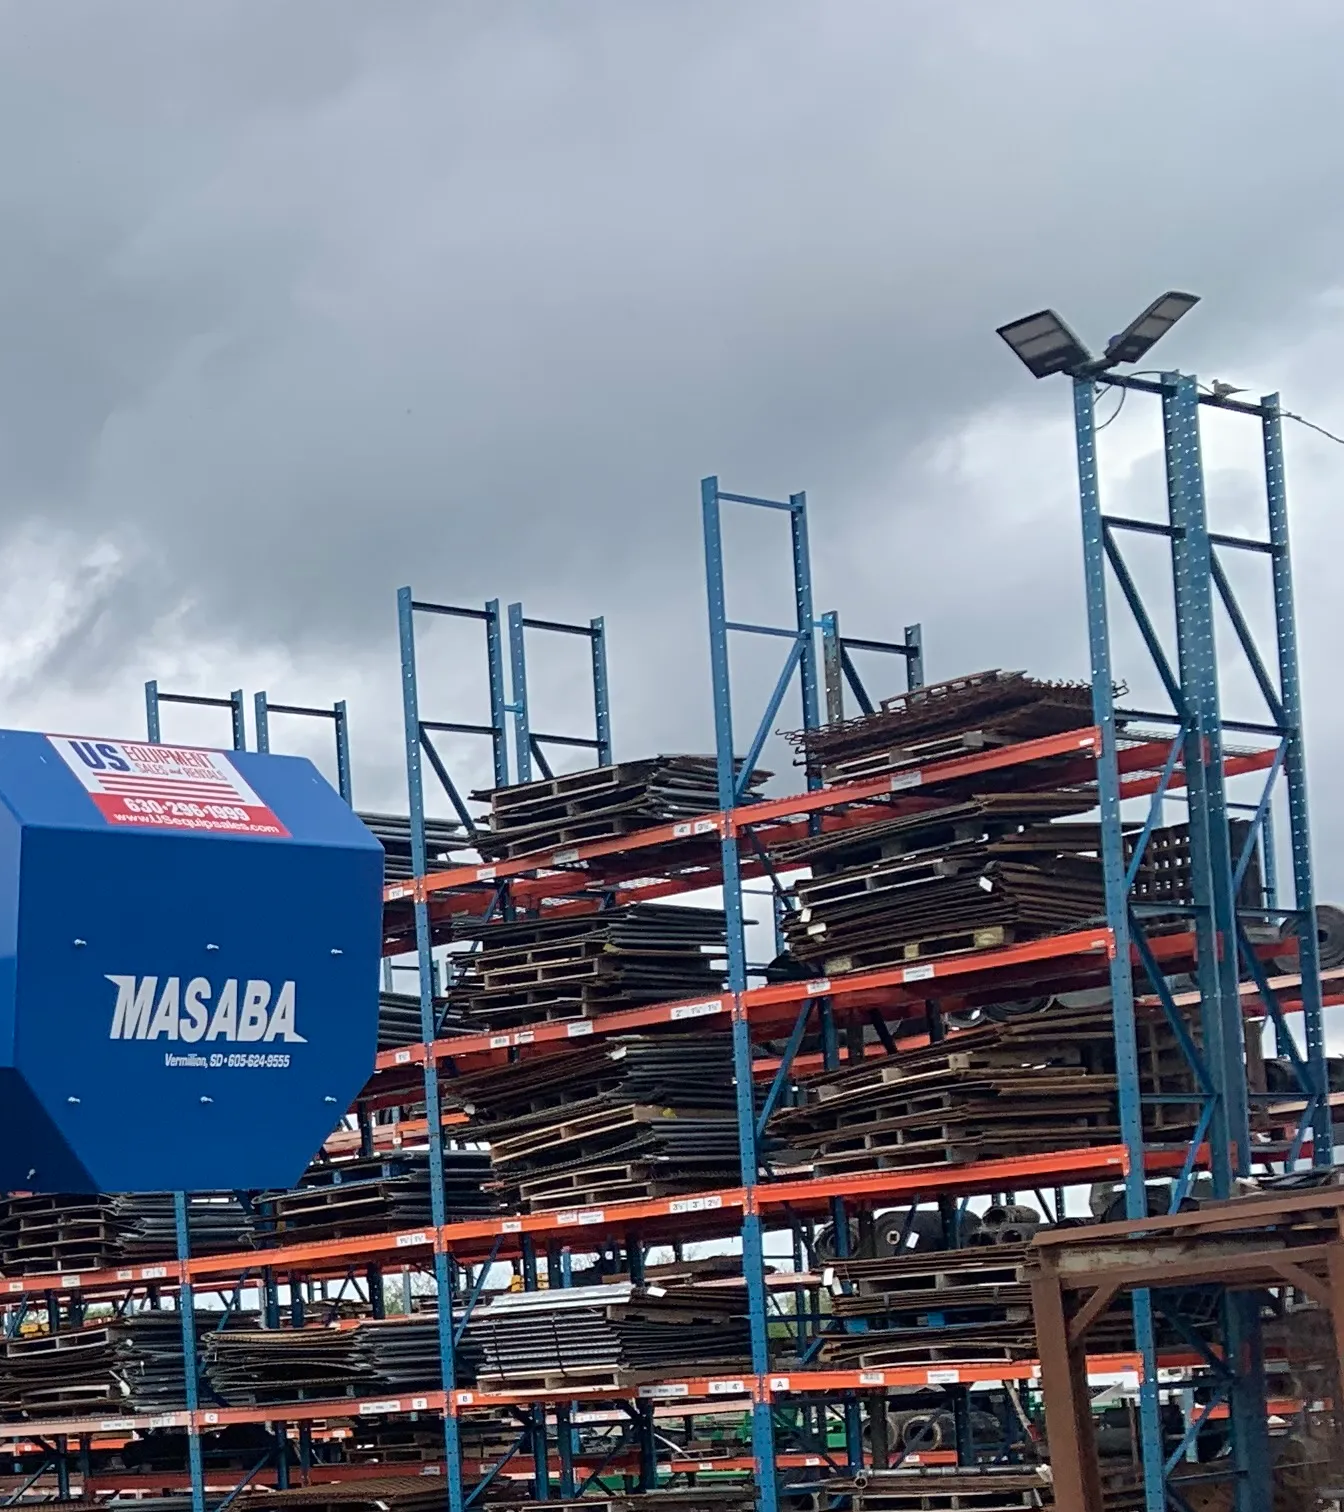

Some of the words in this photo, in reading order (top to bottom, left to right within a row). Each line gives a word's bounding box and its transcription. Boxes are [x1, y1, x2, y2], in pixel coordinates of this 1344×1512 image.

[68, 740, 131, 772] US
[121, 746, 216, 769] EQUIPMENT
[135, 763, 169, 776] SALES
[103, 974, 309, 1043] MASABA
